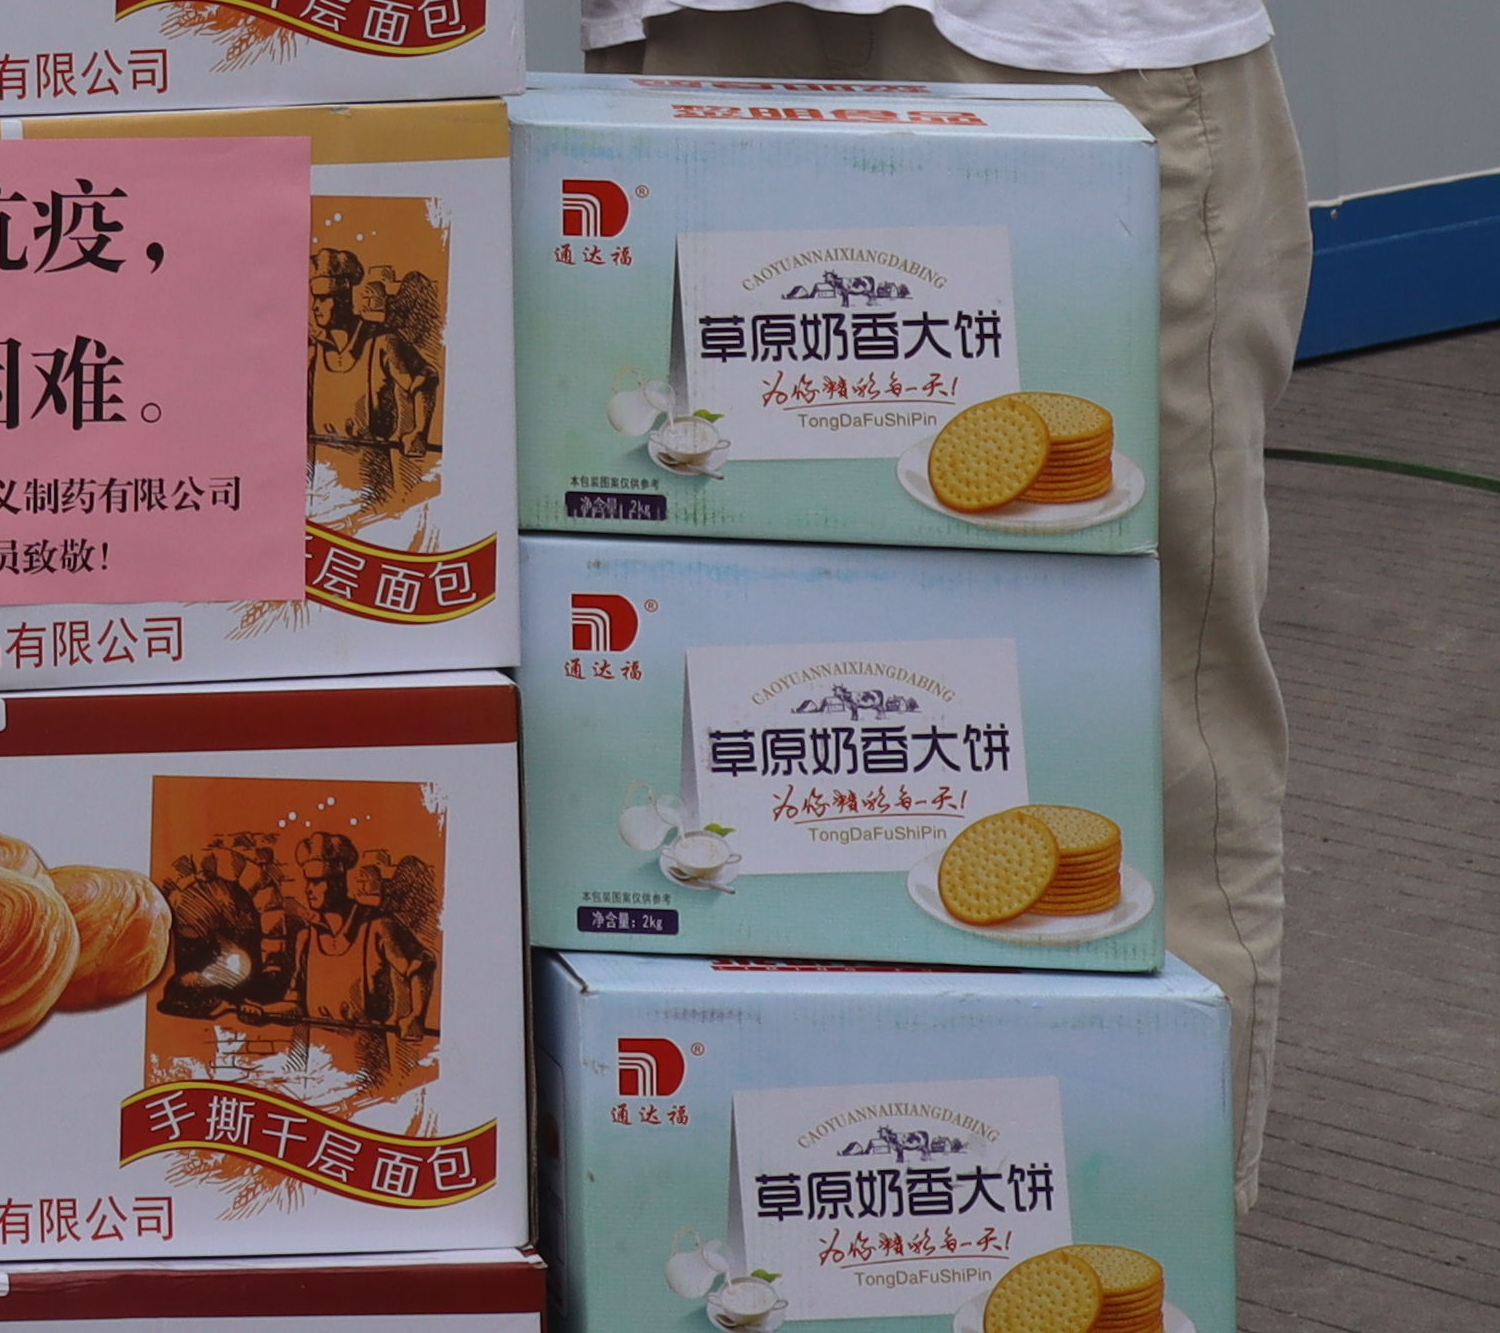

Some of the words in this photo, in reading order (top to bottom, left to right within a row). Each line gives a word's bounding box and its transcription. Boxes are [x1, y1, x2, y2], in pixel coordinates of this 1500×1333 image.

[554, 244, 633, 267] 通达福
[742, 247, 949, 292] CAOYUANNAIXIANGDABING
[699, 310, 1002, 362] 草原奶香大饼
[797, 412, 938, 429] TongDaFuShiPin
[569, 475, 660, 491] 本包装图案仅供参考
[564, 660, 643, 682] 通达福
[751, 661, 956, 706] CAOYUANNAIXIANGDABING
[708, 723, 1011, 777] 草原奶香大饼
[808, 825, 948, 843] TongDaFuShiPin
[581, 890, 672, 906] 本包装图案仅供参考
[610, 1104, 690, 1126] 通达福
[797, 1102, 1001, 1149] CAOYUANNAIXIANGDABING
[145, 1091, 473, 1196] 手撕千层面包
[754, 1164, 1055, 1222] 草原奶香大饼
[854, 1268, 993, 1287] TongDaFuShiPin
